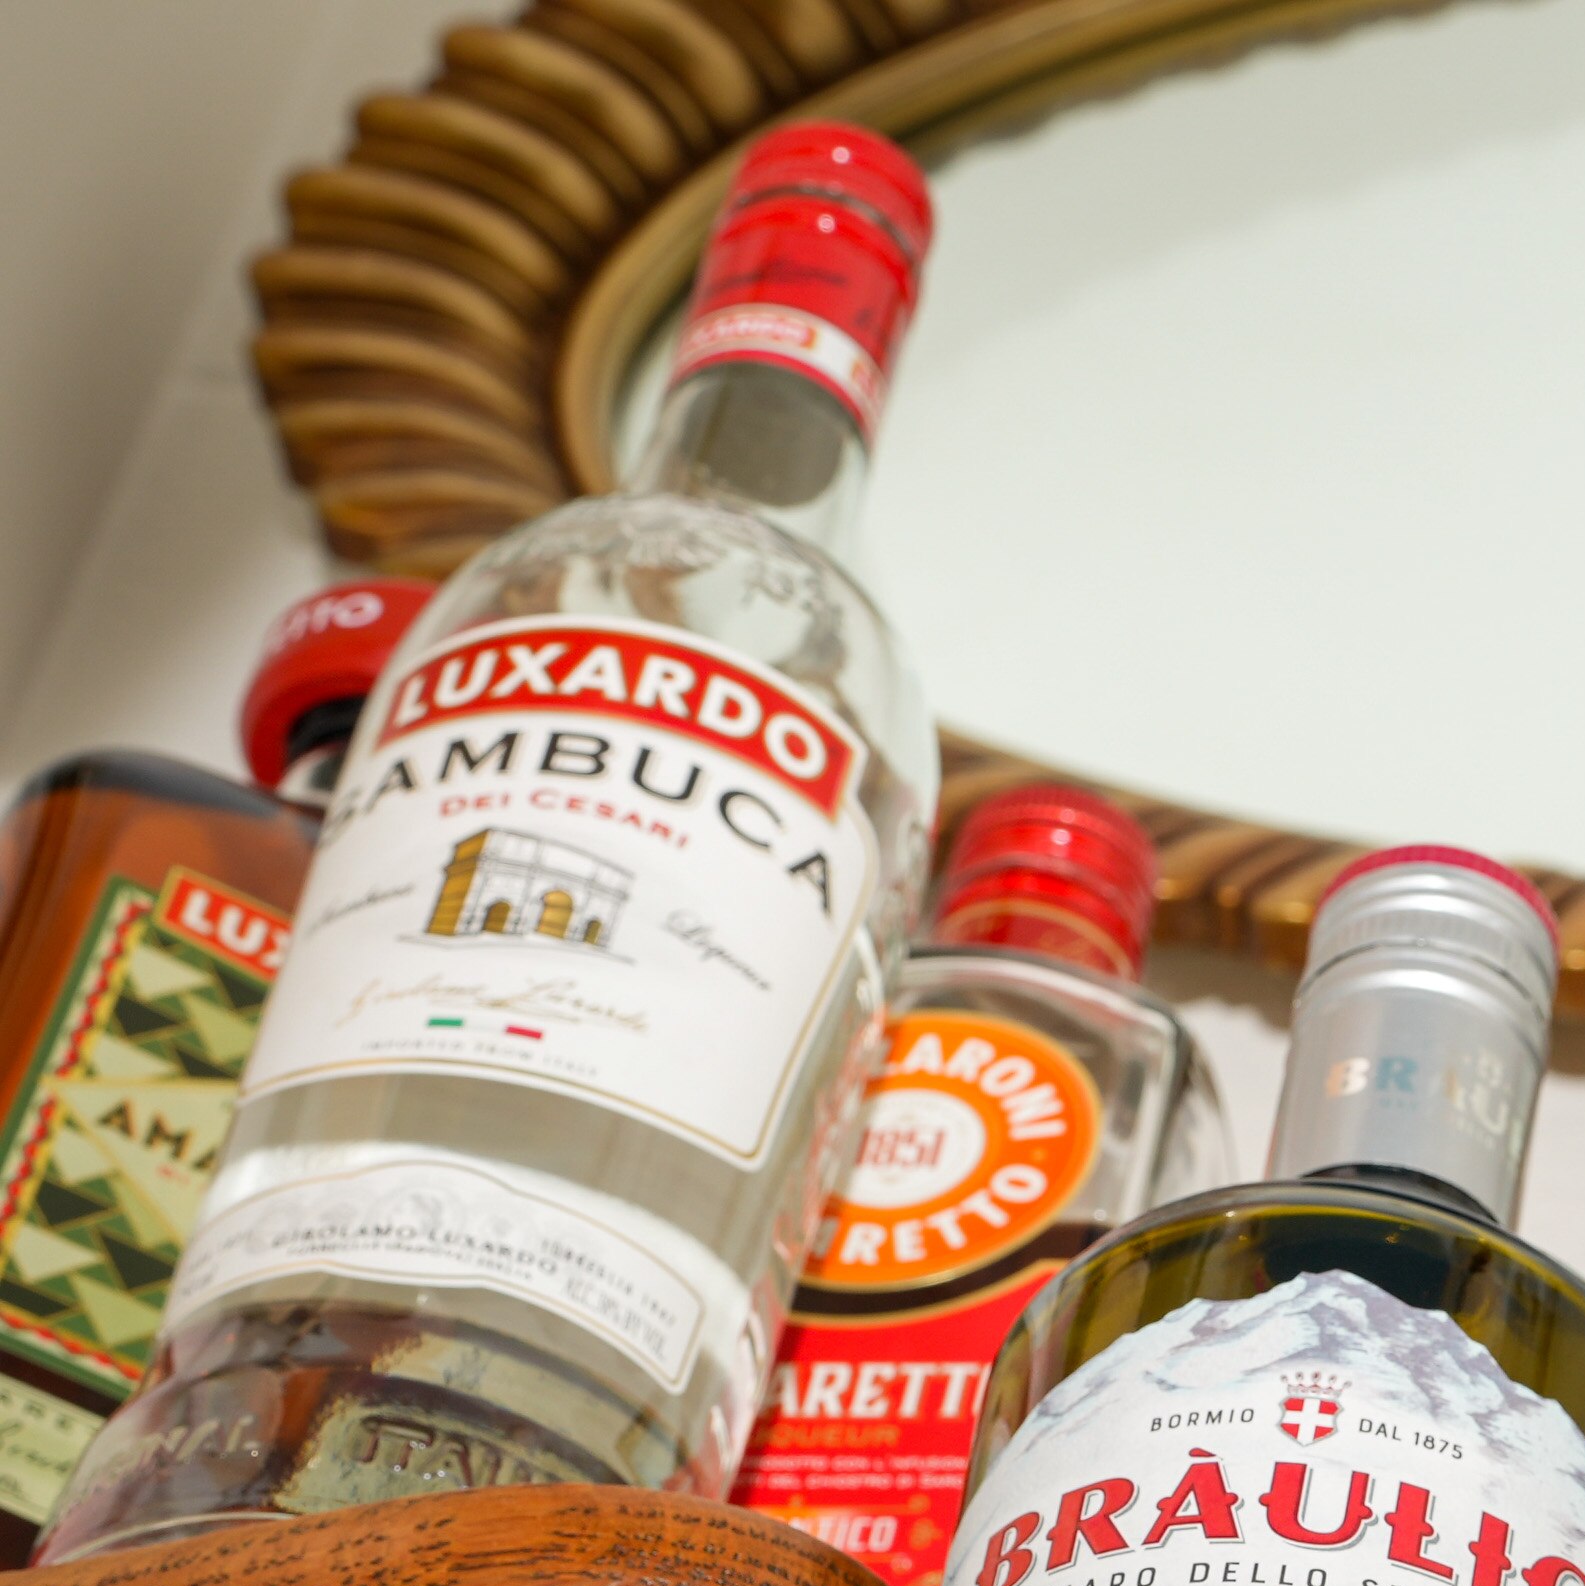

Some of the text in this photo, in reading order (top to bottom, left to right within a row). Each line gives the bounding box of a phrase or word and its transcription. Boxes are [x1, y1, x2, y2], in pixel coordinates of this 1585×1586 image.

[394, 641, 829, 781] LUXARDO
[441, 785, 691, 850] DEI CESARI
[430, 1228, 559, 1277] LUXARDO
[1149, 1408, 1465, 1460] BORMIO DAL 1875
